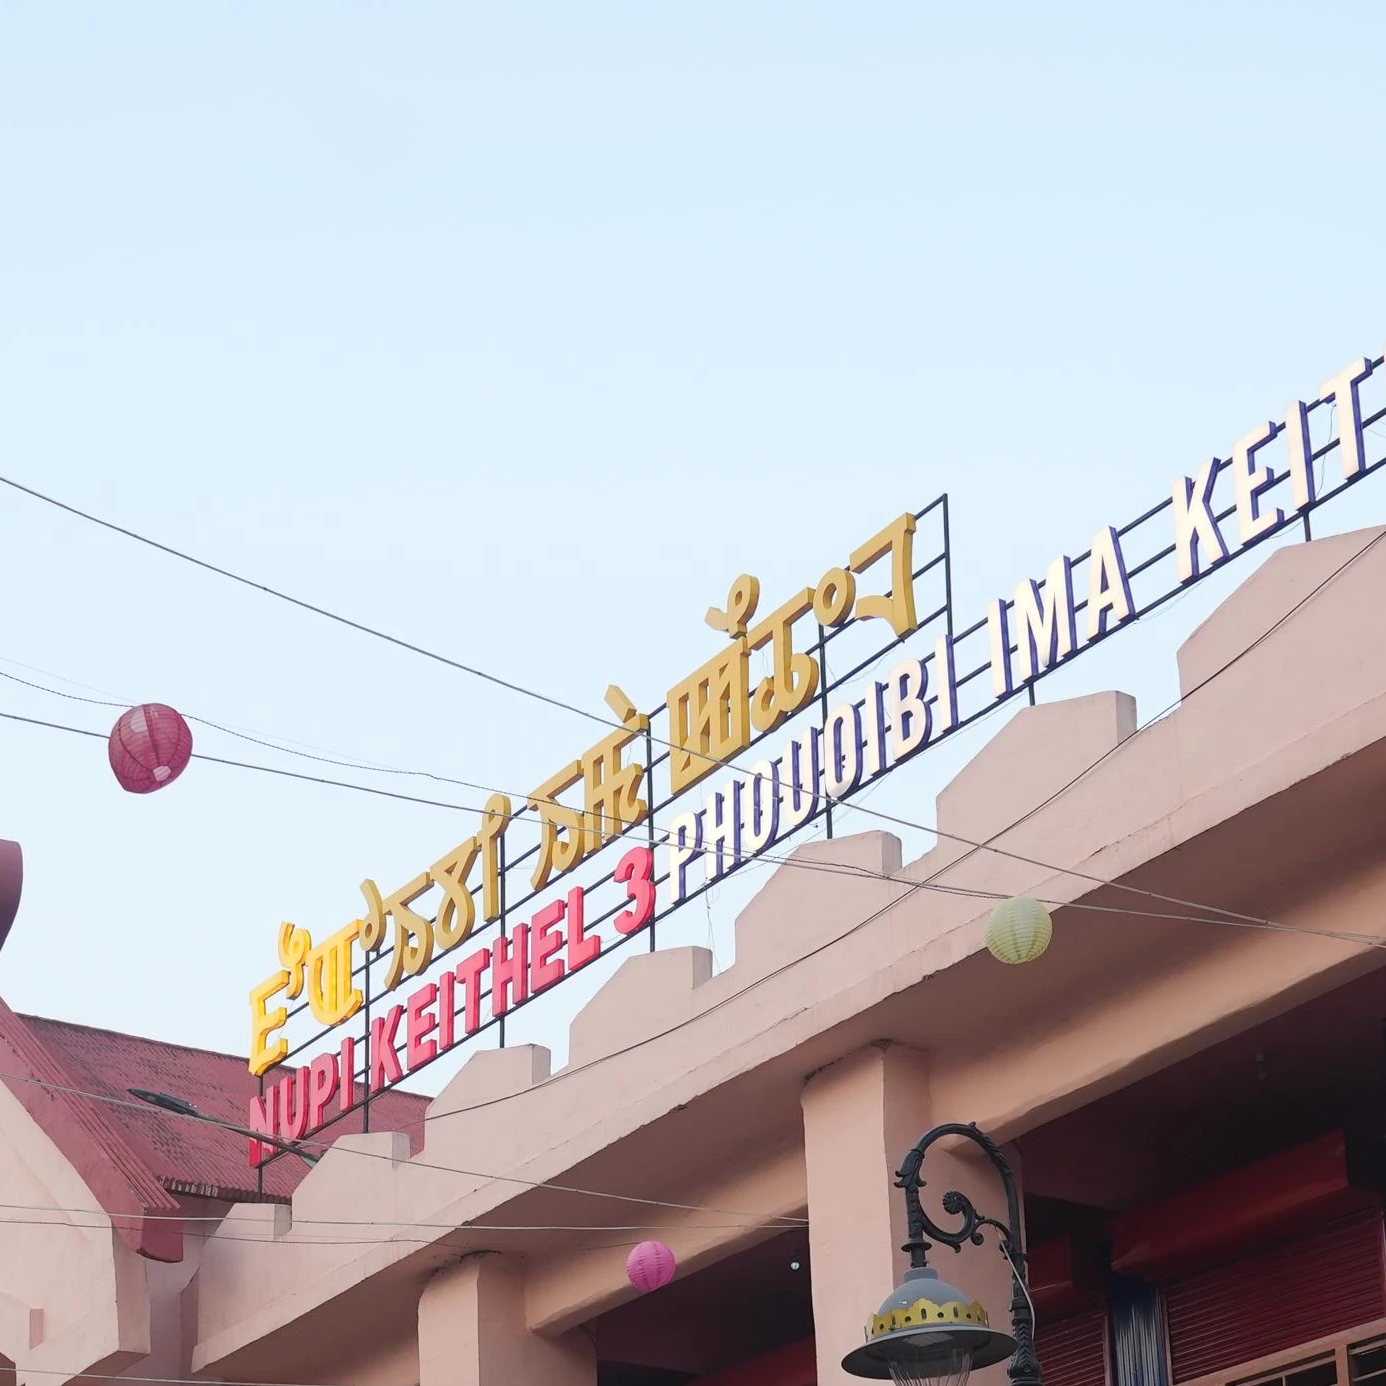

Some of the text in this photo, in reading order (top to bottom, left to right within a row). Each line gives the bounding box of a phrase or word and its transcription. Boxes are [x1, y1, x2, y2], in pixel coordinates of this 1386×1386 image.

[249, 1036, 355, 1168] NUPI
[370, 886, 602, 1095] KEITHEL
[613, 846, 657, 936] 3
[668, 633, 960, 906] PHOUOIBI
[987, 524, 1140, 701] IMA
